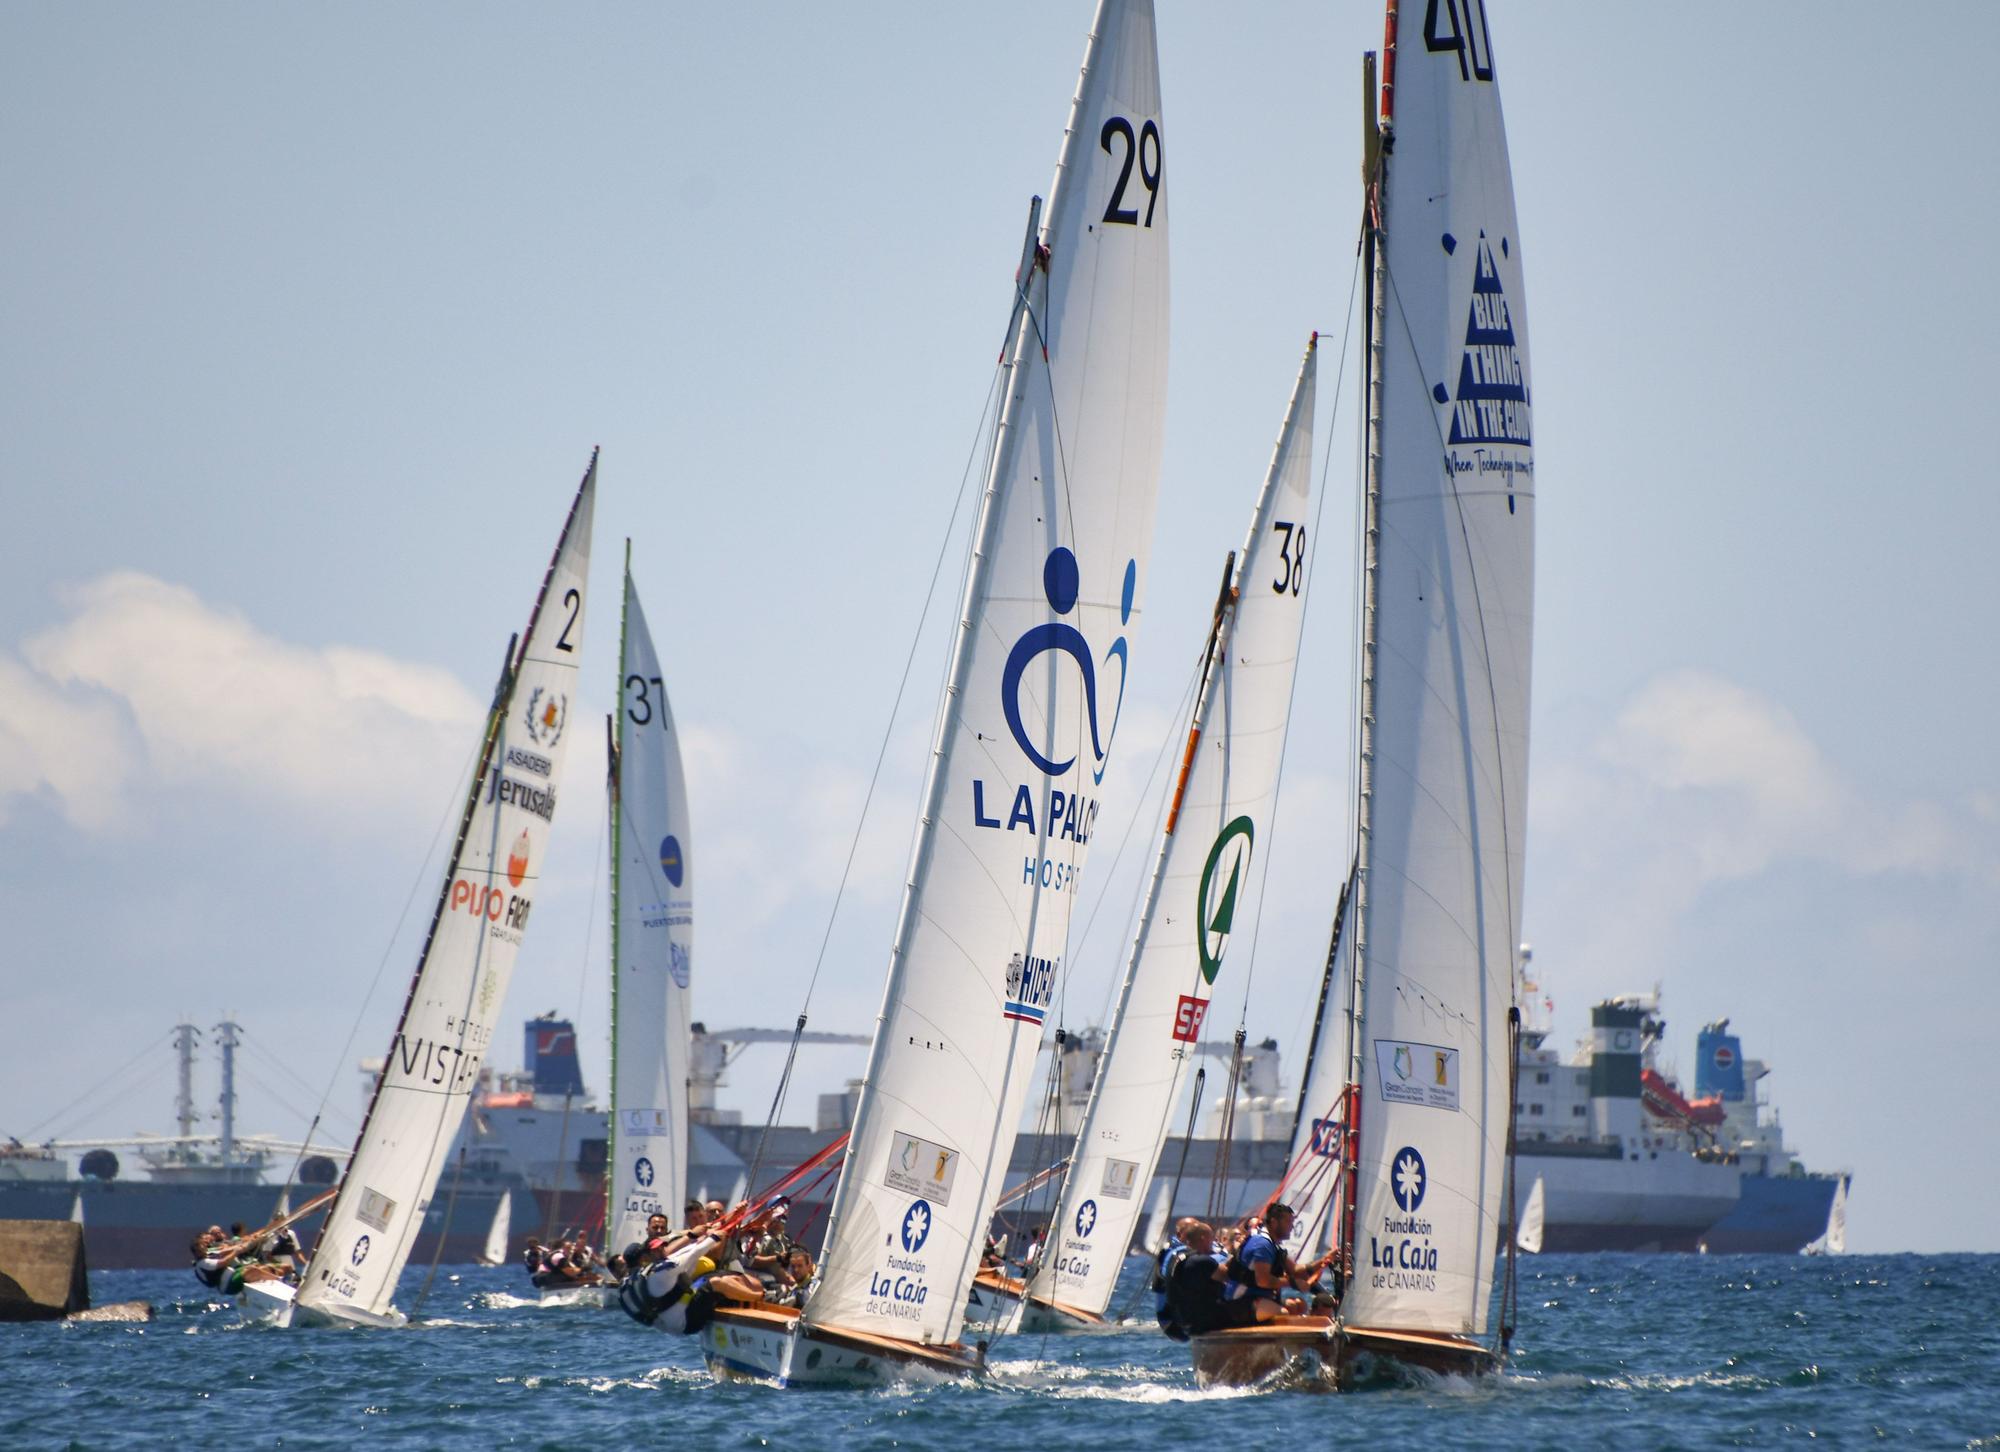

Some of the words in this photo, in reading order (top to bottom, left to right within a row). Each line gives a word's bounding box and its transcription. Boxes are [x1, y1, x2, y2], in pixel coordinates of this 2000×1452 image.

[1423, 0, 1493, 81] 40
[1100, 116, 1161, 228] 29
[1479, 238, 1495, 278] A
[1472, 293, 1509, 330] BLUE
[1463, 345, 1521, 386] THING
[1455, 400, 1480, 438] IN
[1478, 400, 1506, 438] THE
[1272, 521, 1306, 598] 38
[556, 588, 581, 653] 2
[626, 674, 668, 731] 37
[973, 780, 1036, 836] LA
[450, 879, 504, 922] PISO
[1384, 1216, 1432, 1236] Fundación
[887, 1254, 926, 1275] Fundación
[1069, 1256, 1090, 1277] Caja
[1371, 1237, 1394, 1268] La
[1399, 1238, 1437, 1272] Caja
[870, 1271, 891, 1298] La
[894, 1275, 928, 1305] Caja
[1372, 1271, 1386, 1289] de
[1388, 1272, 1436, 1292] CANARIAS
[866, 1298, 878, 1314] de
[880, 1301, 922, 1322] CANARIAS
